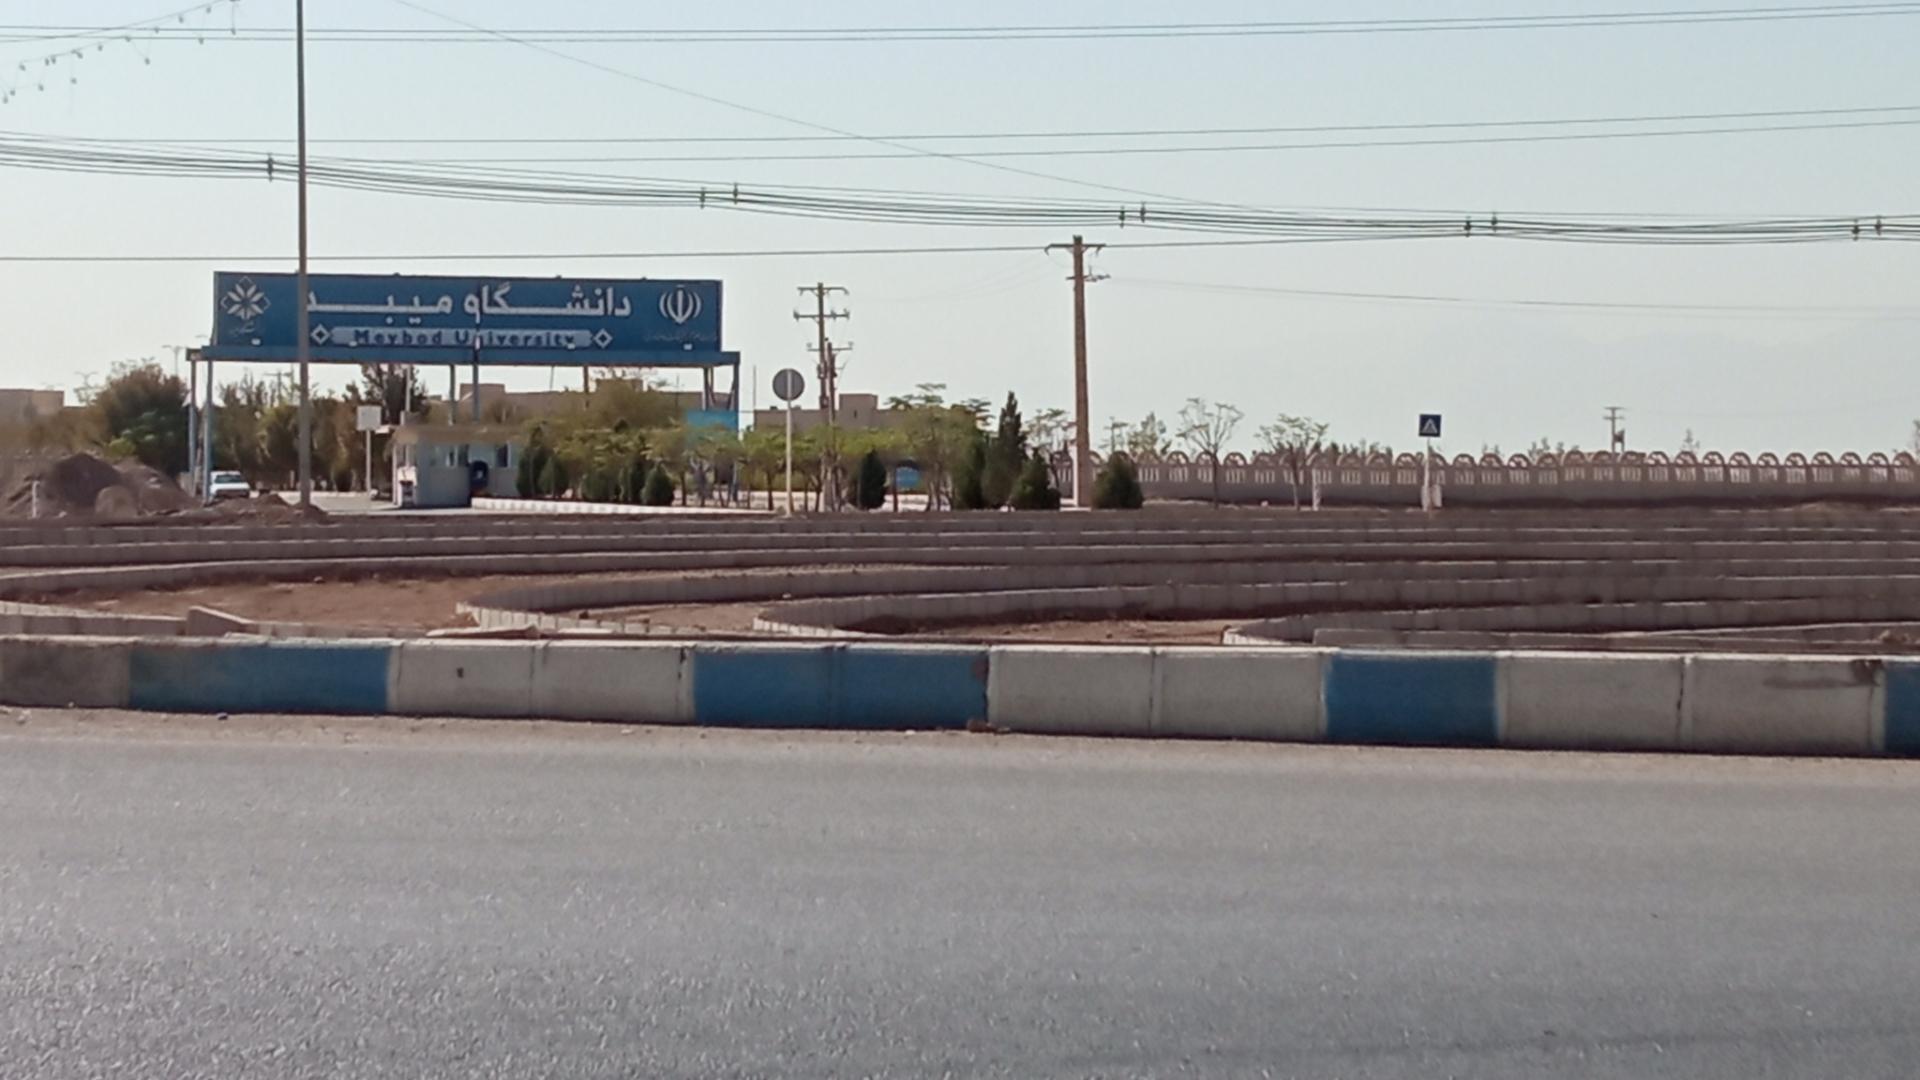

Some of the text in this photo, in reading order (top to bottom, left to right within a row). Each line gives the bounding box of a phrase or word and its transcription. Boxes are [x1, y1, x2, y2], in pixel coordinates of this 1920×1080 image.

[306, 281, 632, 325] دانشگاه میبد
[354, 328, 443, 347] Meybod
